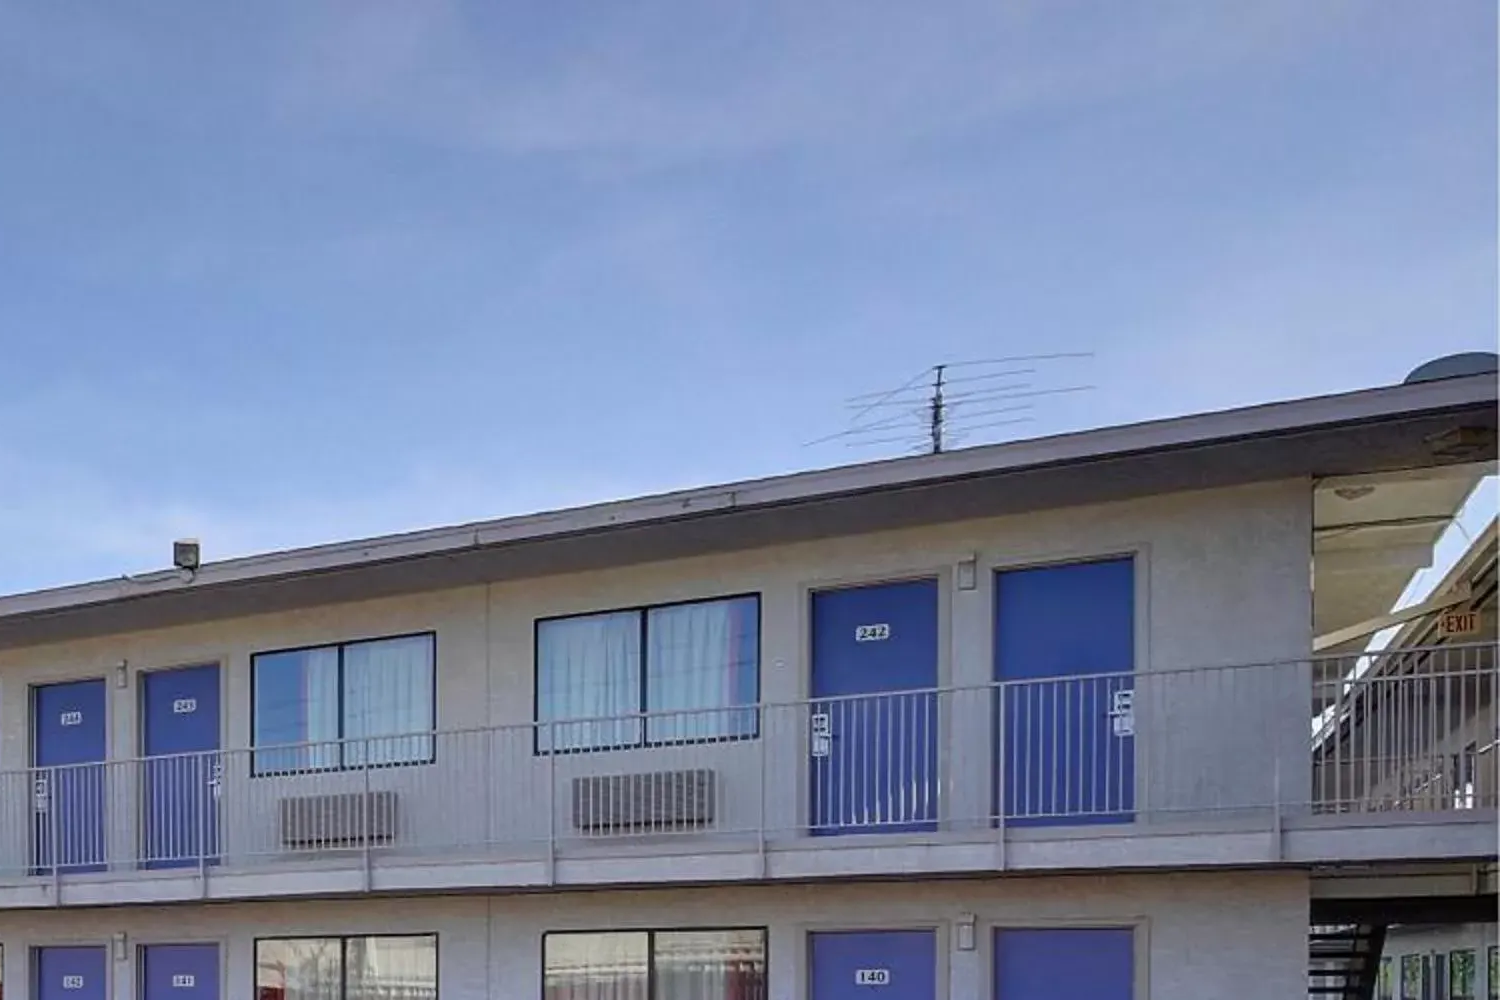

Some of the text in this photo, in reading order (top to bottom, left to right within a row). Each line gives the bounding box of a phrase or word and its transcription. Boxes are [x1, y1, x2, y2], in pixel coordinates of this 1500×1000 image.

[1446, 613, 1477, 633] EXIT
[859, 625, 887, 639] 242
[859, 971, 886, 983] 140
